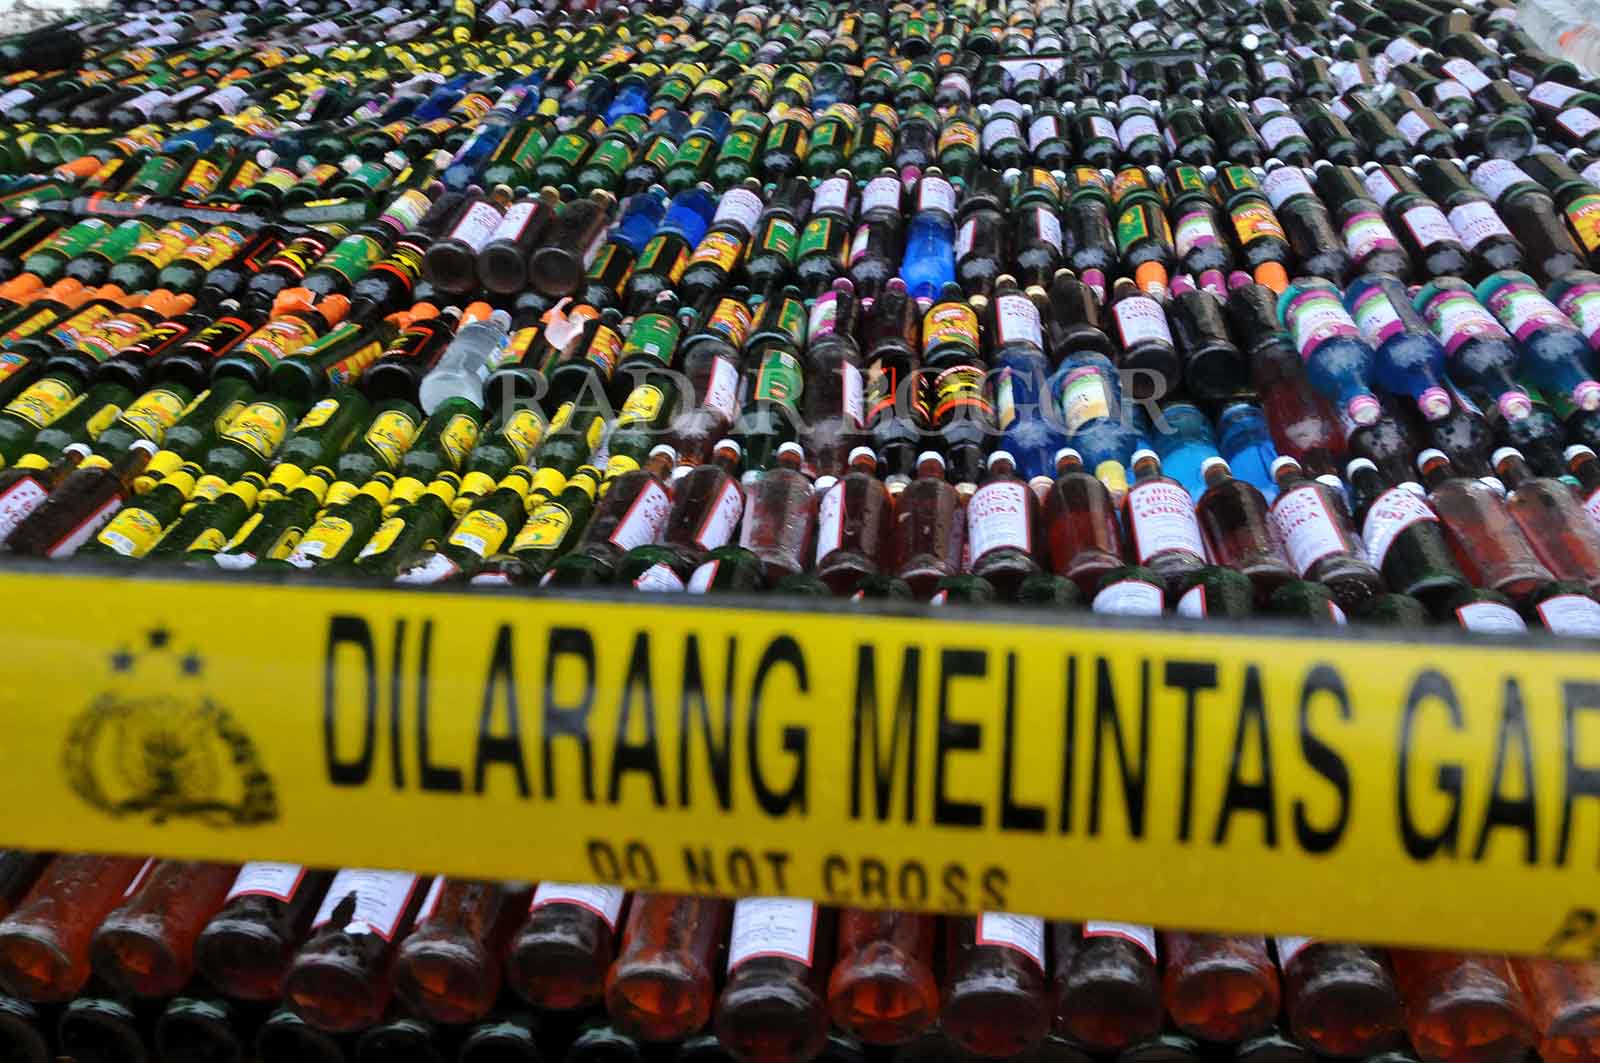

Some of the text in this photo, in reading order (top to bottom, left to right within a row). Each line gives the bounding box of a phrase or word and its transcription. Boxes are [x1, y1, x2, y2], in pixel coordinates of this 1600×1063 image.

[323, 615, 810, 818] DILARANG
[849, 643, 1354, 853] MELINTAS
[587, 840, 1009, 911] DO NOT CROSS
